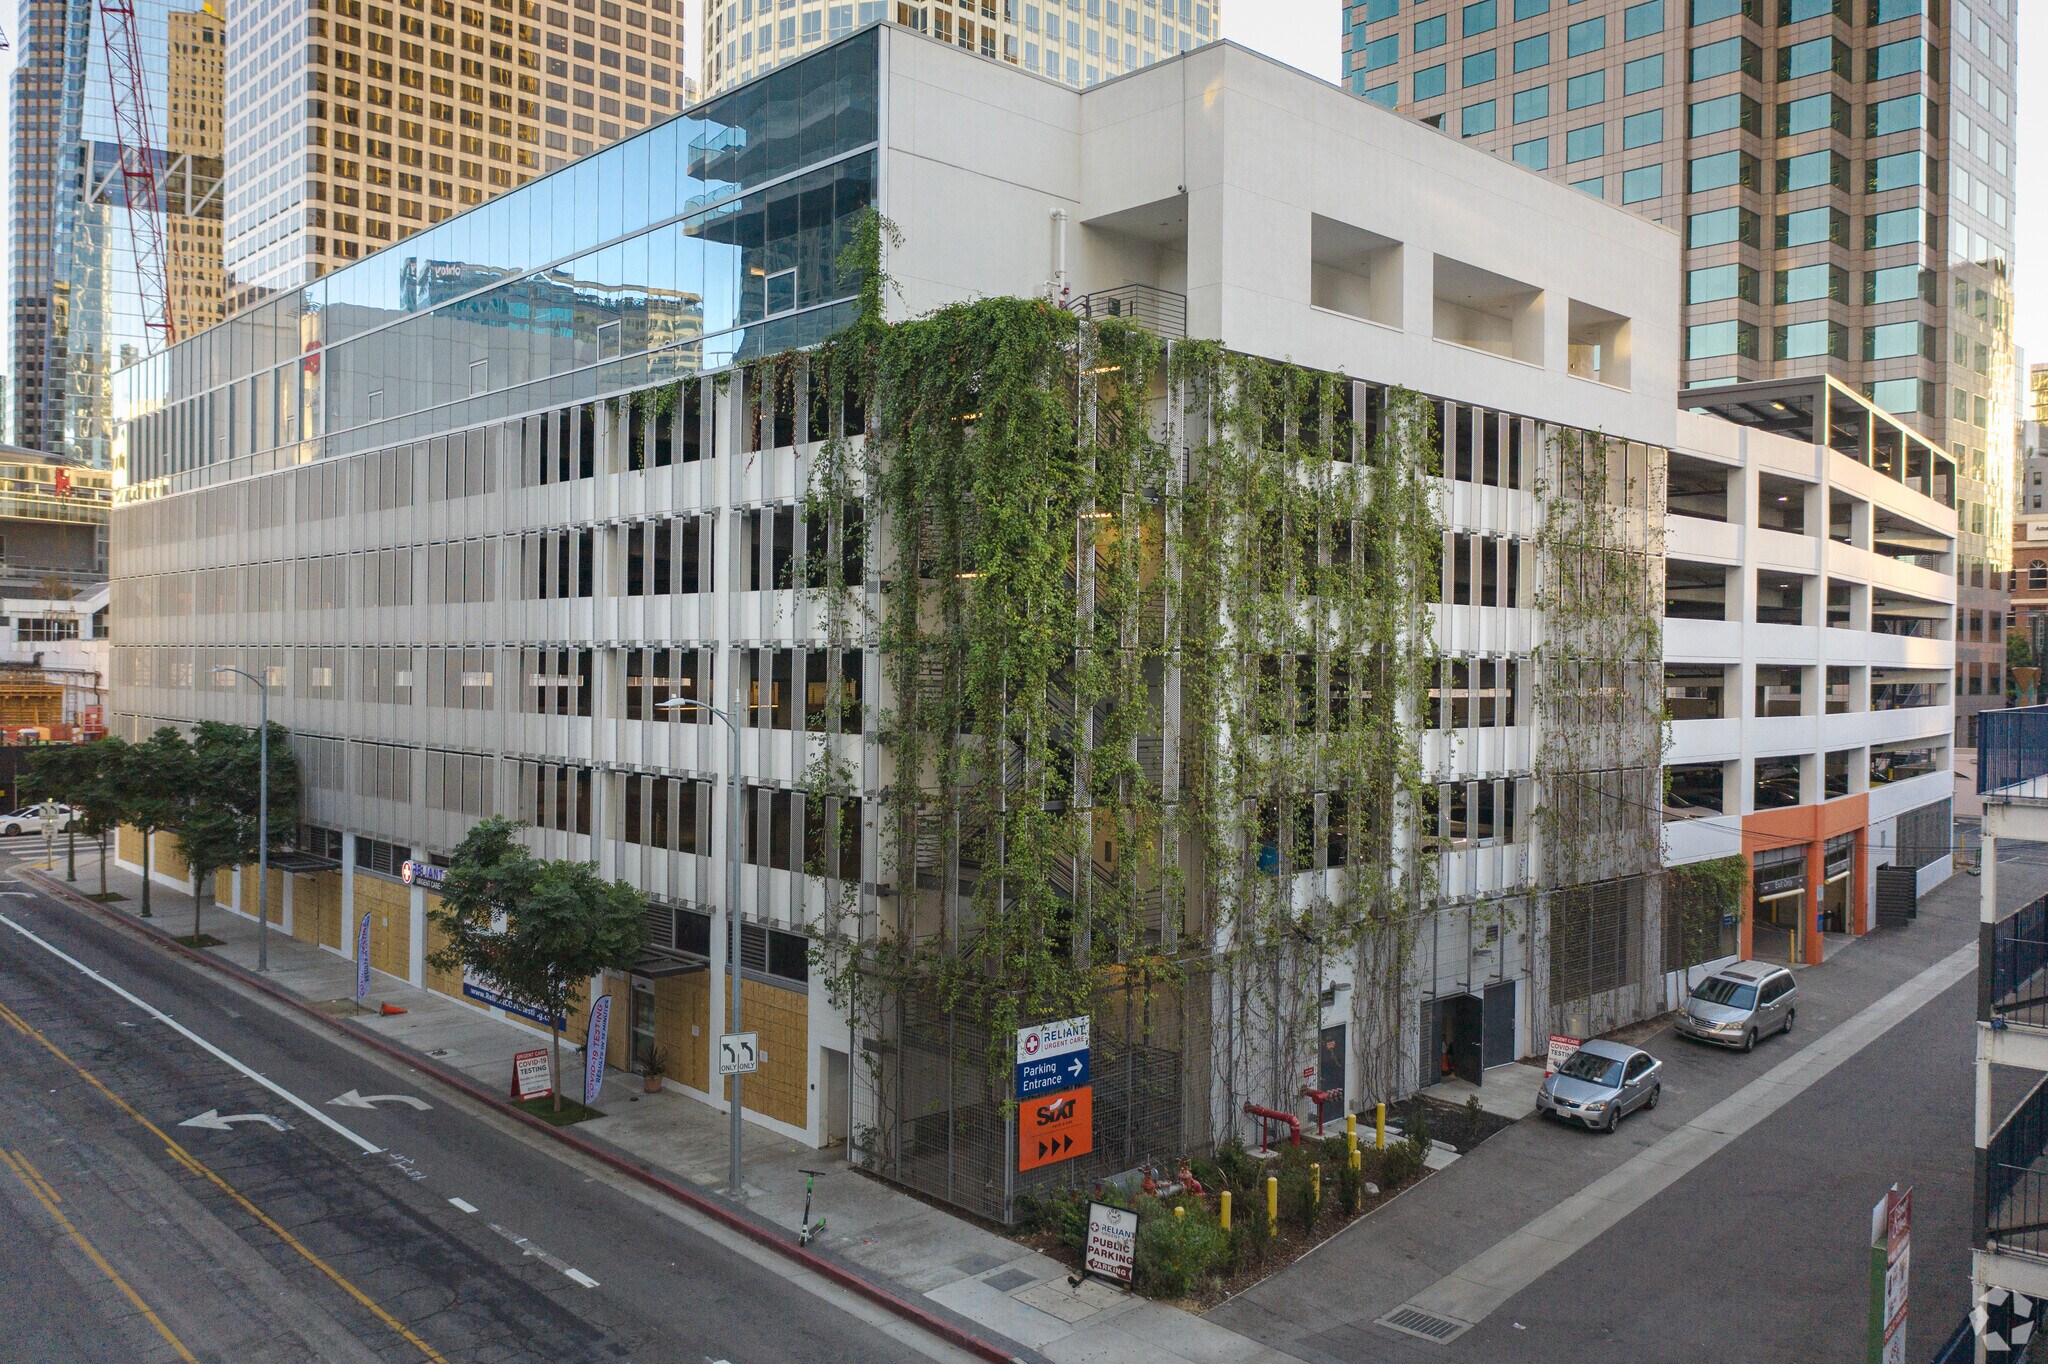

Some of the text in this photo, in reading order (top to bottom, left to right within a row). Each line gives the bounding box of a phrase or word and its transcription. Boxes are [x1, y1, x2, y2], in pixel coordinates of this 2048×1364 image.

[593, 1004, 603, 1046] TESTING
[1044, 1025, 1086, 1042] RELIANT
[1044, 1036, 1085, 1050] URGENT CARE
[519, 1057, 547, 1068] COVID-19
[520, 1064, 547, 1075] TESTING
[721, 1062, 755, 1072] ONLY ONLY
[1023, 1062, 1057, 1077] Parking
[1023, 1075, 1062, 1091] Entrance
[1102, 1224, 1135, 1239] RELIANT
[1092, 1236, 1130, 1253] PUBLIC
[1087, 1245, 1134, 1265] PARKING
[1092, 1261, 1126, 1275] PARKING
